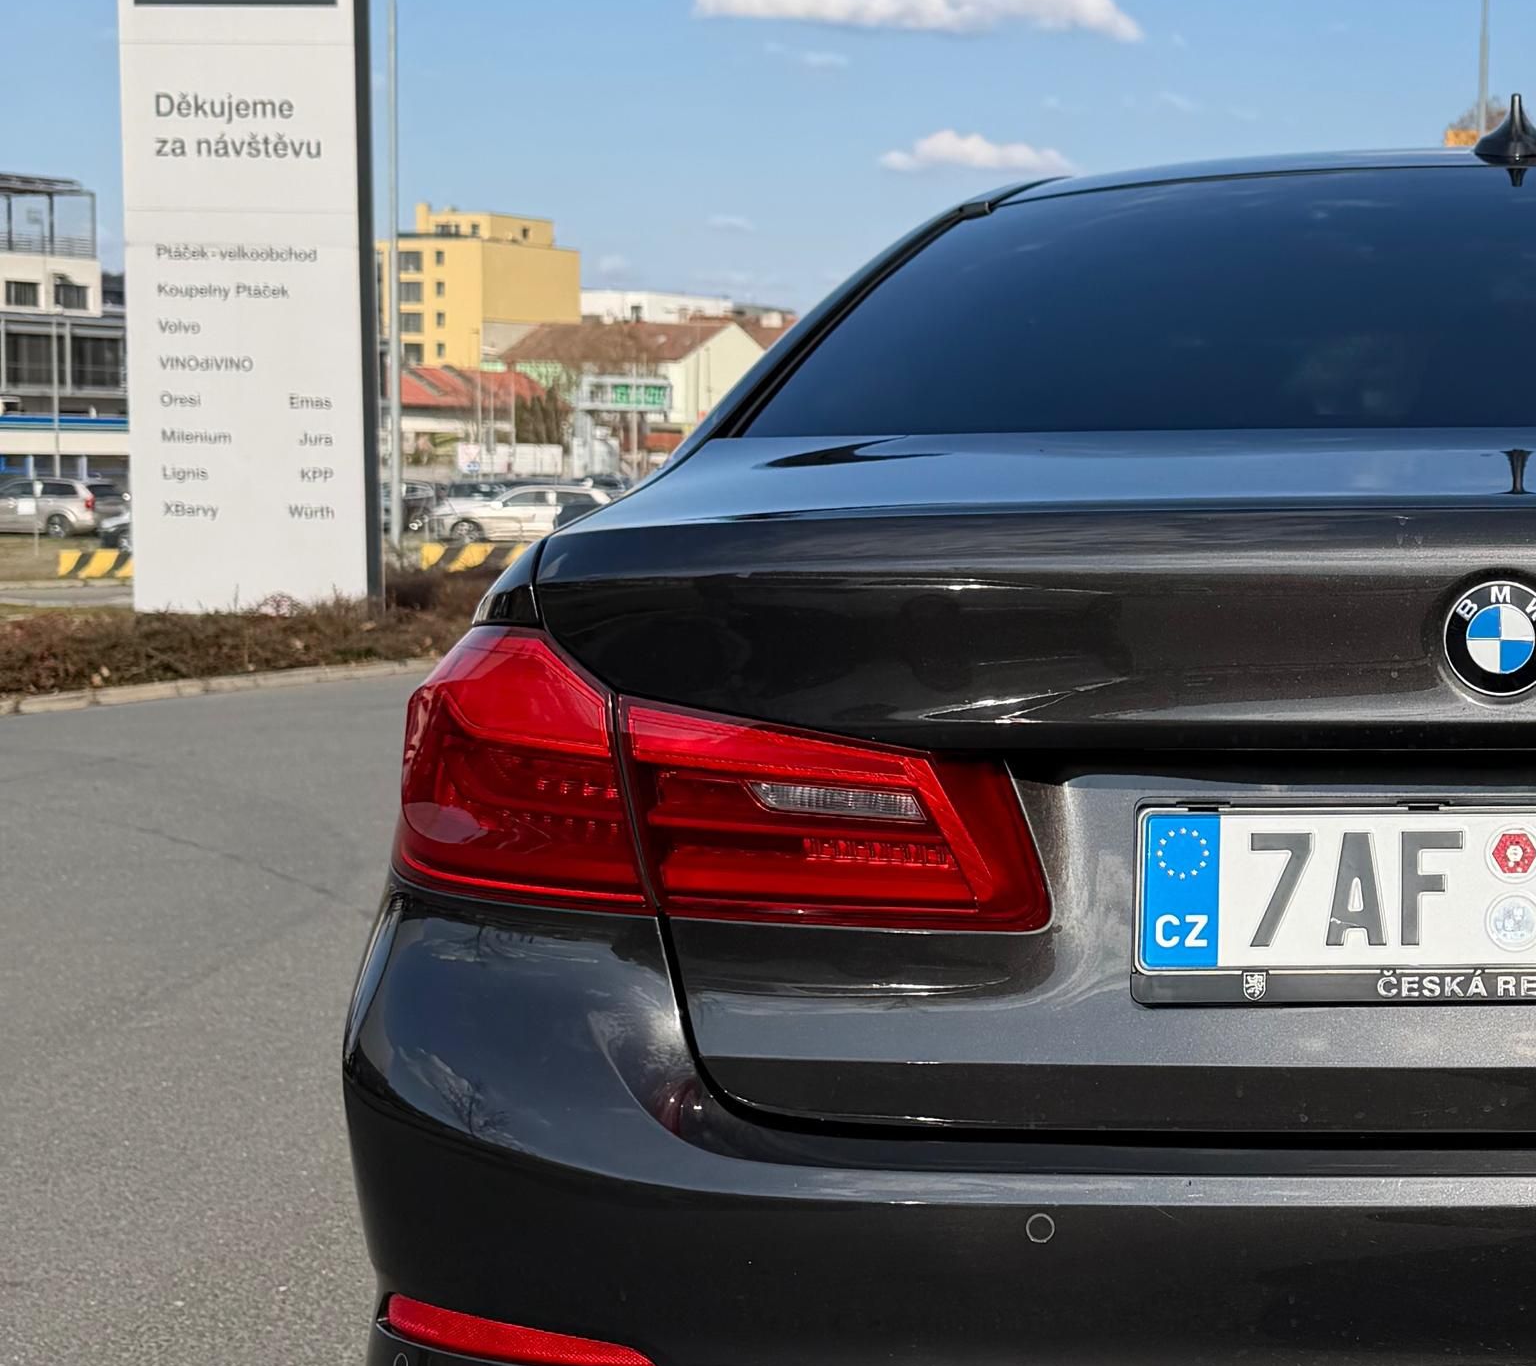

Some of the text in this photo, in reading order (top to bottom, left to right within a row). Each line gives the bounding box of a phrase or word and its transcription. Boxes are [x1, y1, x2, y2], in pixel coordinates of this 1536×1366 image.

[155, 92, 294, 123] Děkujeme
[155, 132, 322, 159] za návštěvu
[156, 243, 209, 260] Ptáček
[220, 244, 317, 262] velkoobchod
[157, 282, 290, 301] Koupelny Ptáček
[157, 318, 201, 334] Volvo
[159, 355, 253, 372] VINOdiVINO
[160, 390, 201, 407] Oresi
[289, 393, 333, 410] Emas
[161, 428, 232, 444] Milenium
[299, 432, 333, 447] Jura
[162, 465, 209, 483] Lignis
[300, 467, 334, 482] KPP
[163, 501, 219, 520] XBarvy
[288, 504, 335, 519] Würth
[1249, 830, 1464, 947] 7AF
[1155, 914, 1208, 948] CZ
[1377, 970, 1488, 998] ČESKÁ
